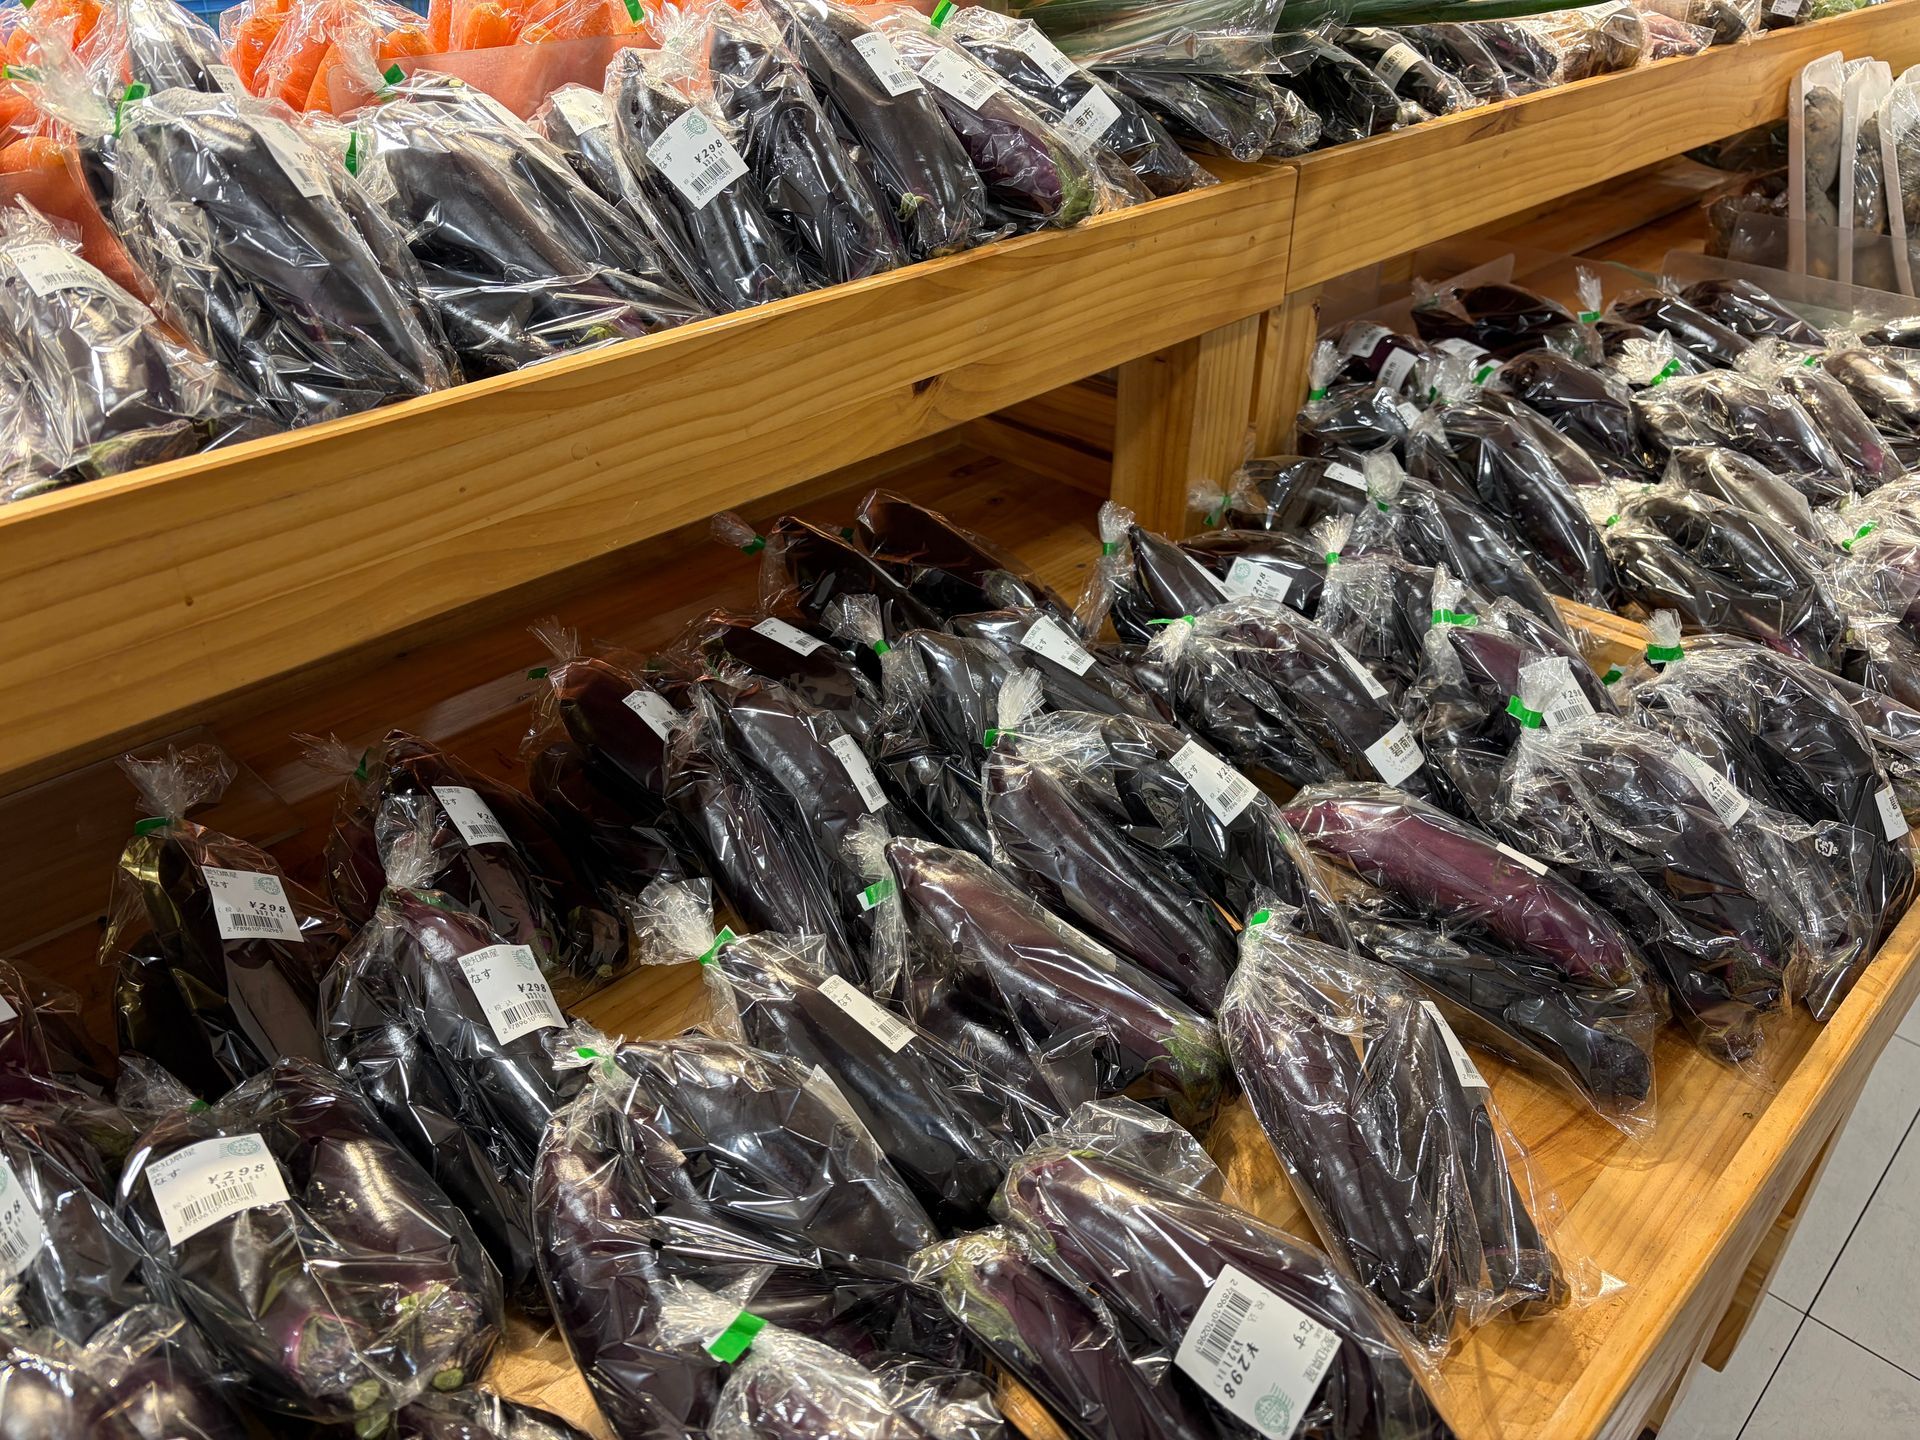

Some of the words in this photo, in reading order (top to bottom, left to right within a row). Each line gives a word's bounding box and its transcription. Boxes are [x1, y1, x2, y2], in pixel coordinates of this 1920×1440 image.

[694, 139, 722, 163] ¥298
[659, 152, 673, 169] なす
[1184, 764, 1198, 779] なす
[210, 880, 228, 889] なす
[249, 901, 286, 913] ¥298
[469, 968, 492, 984] なす
[517, 983, 547, 993] ¥298
[838, 993, 852, 1006] なす
[154, 1168, 182, 1186] なす
[207, 1163, 265, 1184] ¥298
[1230, 1278, 1238, 1286] 2
[1211, 1288, 1230, 1321] 789610
[1293, 1319, 1314, 1350] なす
[1303, 1334, 1337, 1384] 愛知県産
[1223, 1341, 1259, 1399] ¥298
